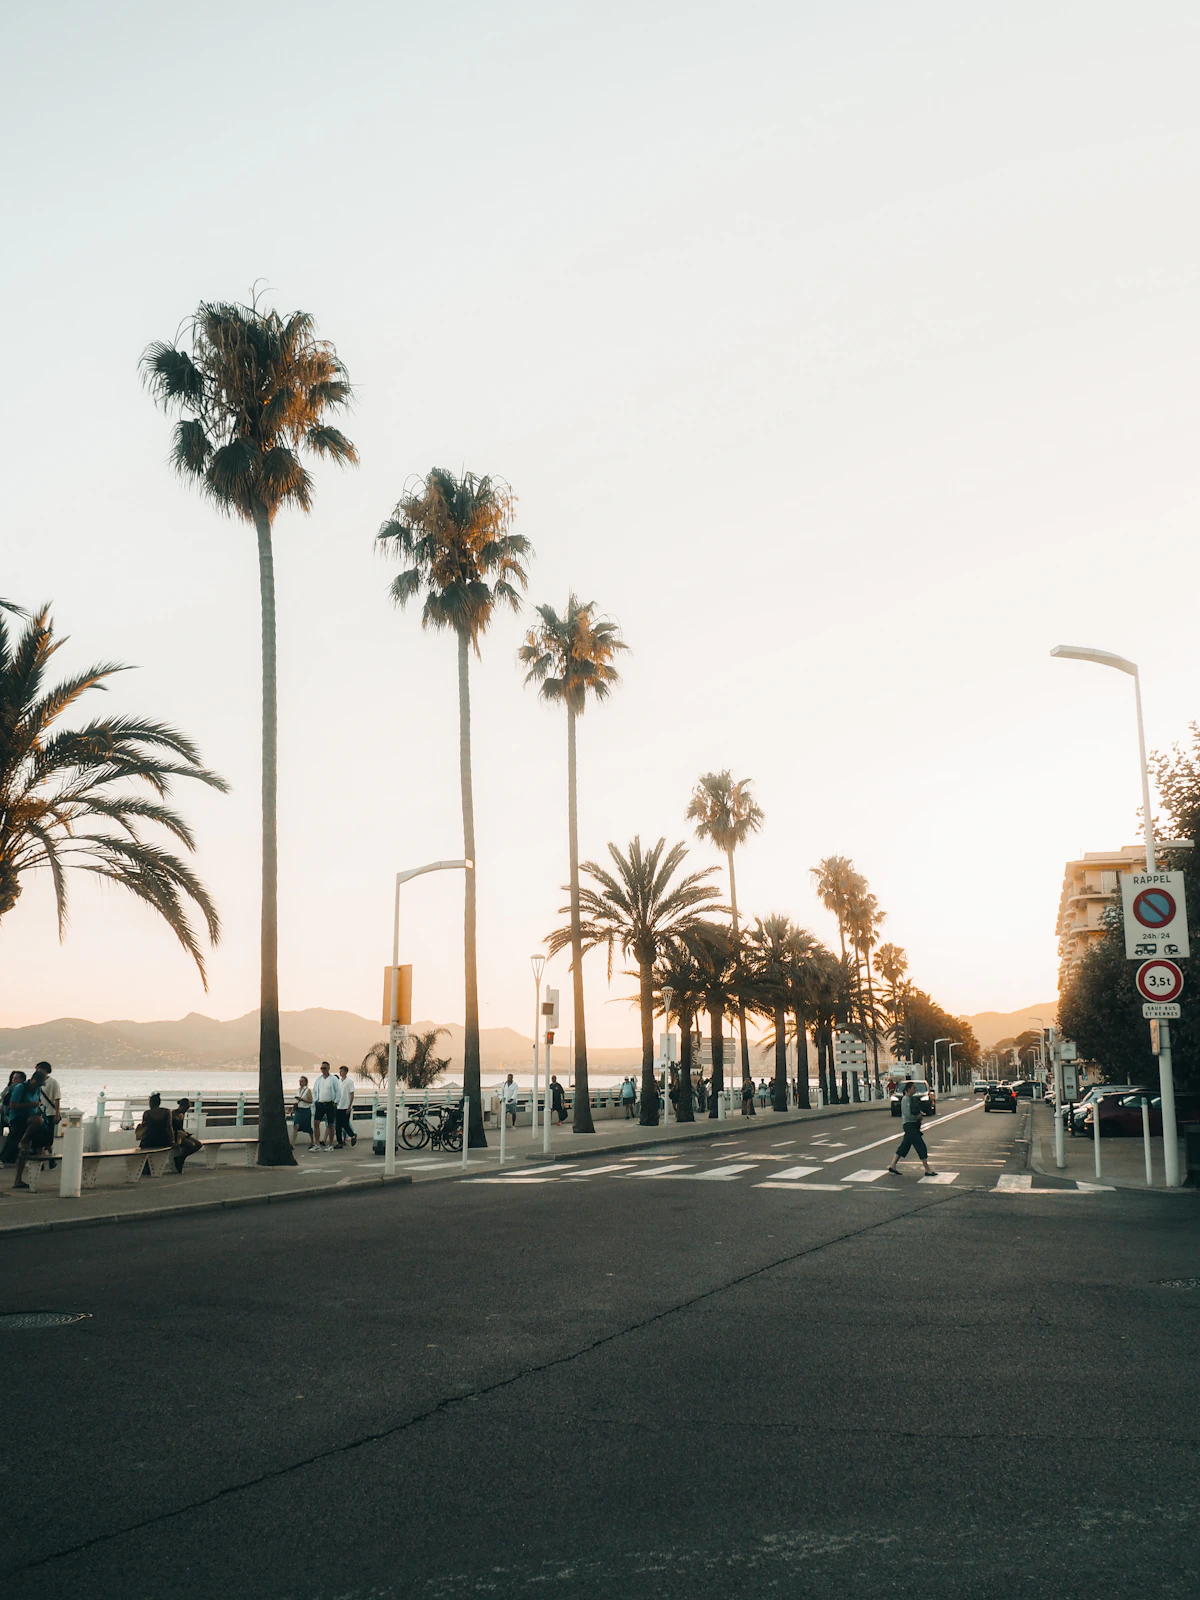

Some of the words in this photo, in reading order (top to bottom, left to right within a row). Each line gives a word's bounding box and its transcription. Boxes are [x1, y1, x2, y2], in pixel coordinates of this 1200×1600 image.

[1133, 874, 1172, 885] RAPPEL
[1142, 932, 1170, 940] 24h/24
[1149, 975, 1172, 988] 3,5t
